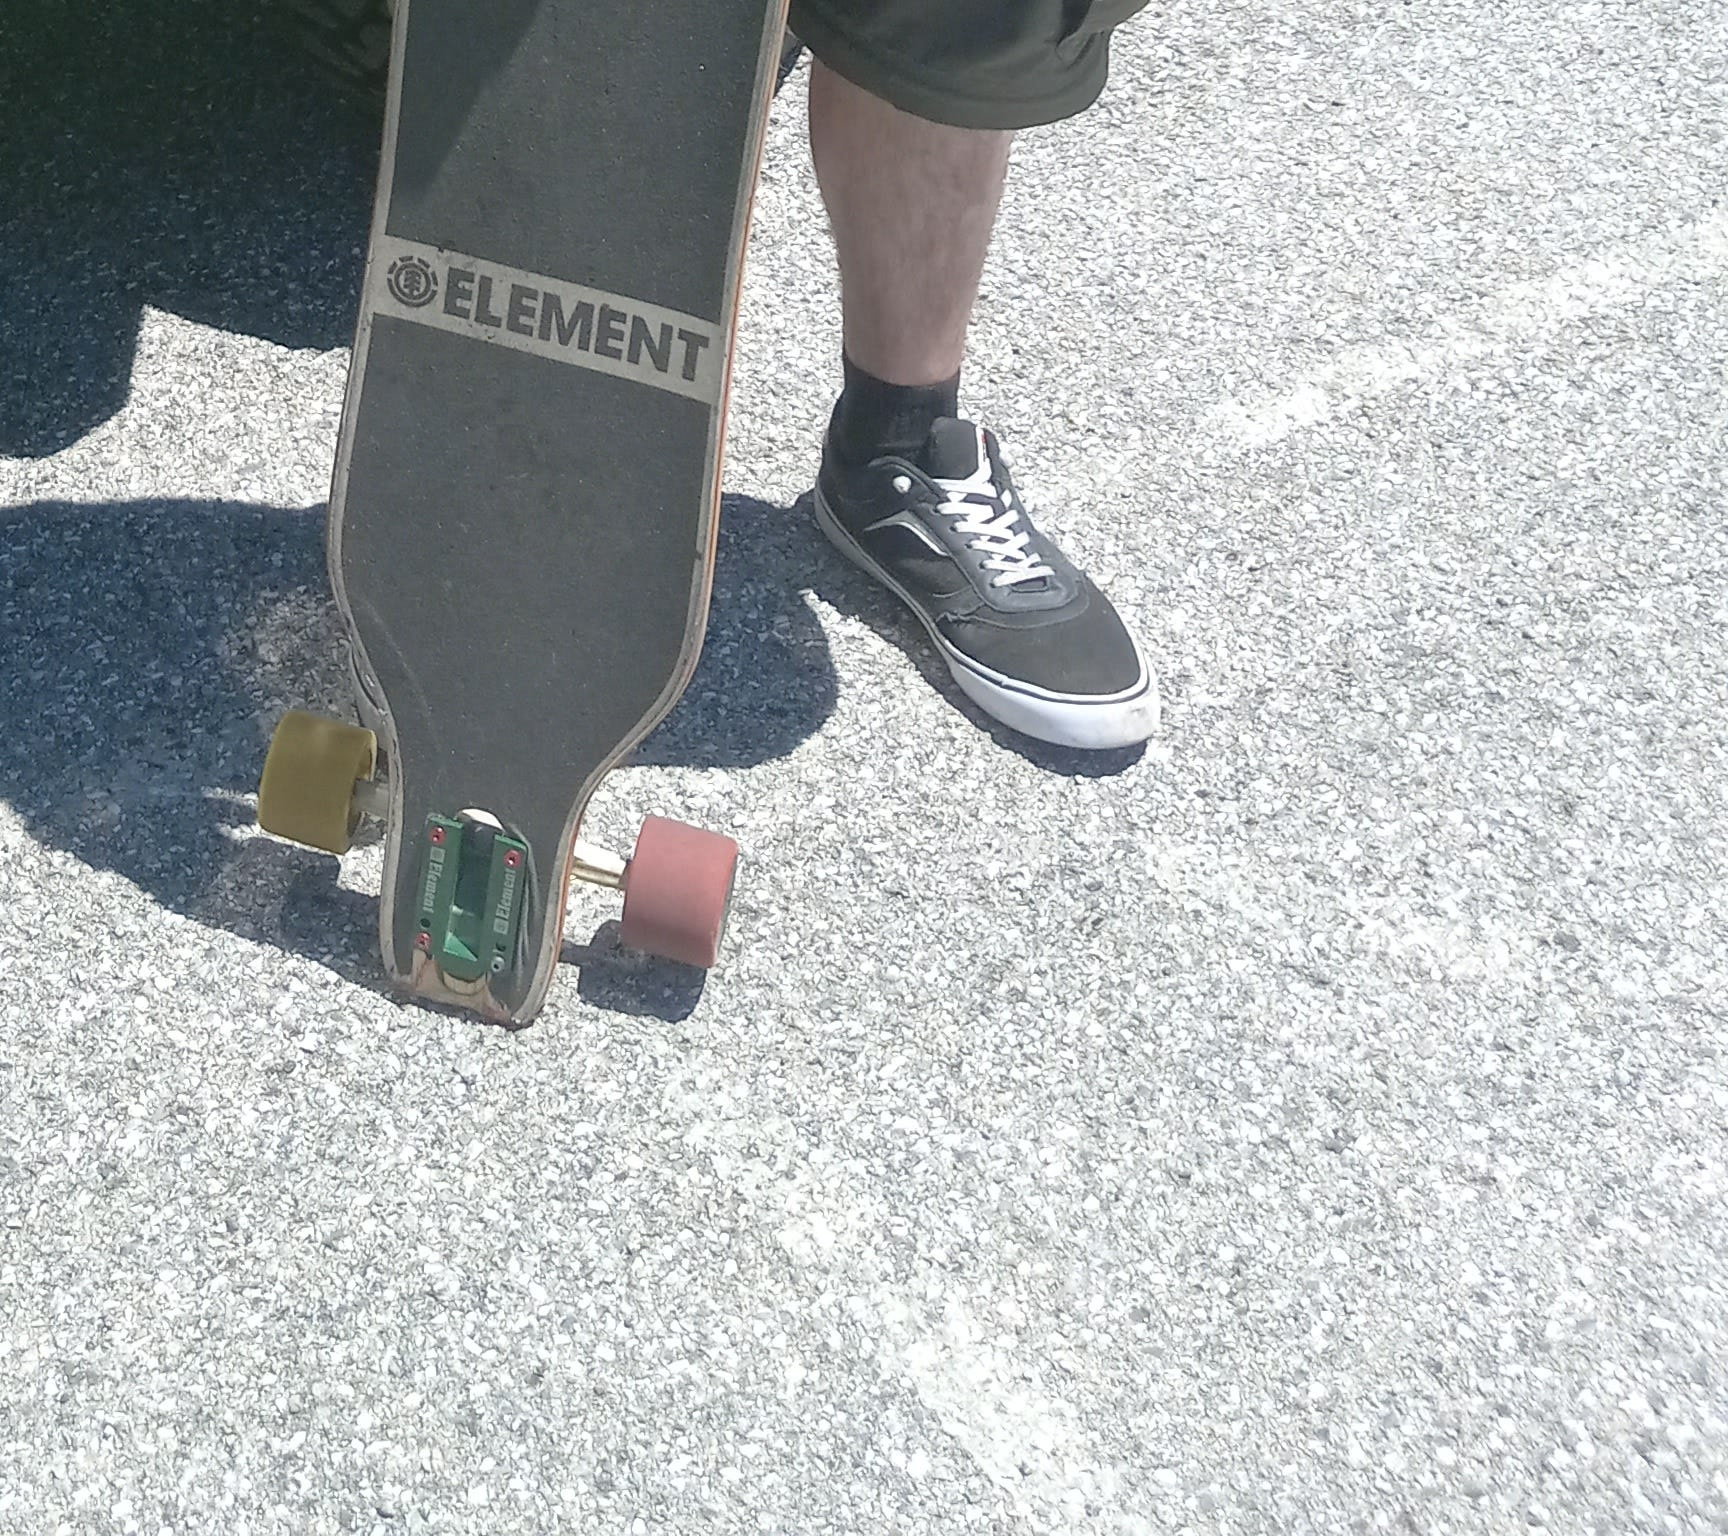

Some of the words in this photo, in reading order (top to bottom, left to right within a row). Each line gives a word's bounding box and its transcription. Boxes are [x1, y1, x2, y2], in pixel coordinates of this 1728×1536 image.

[443, 266, 709, 382] ELEMENT
[422, 861, 444, 914] Element
[495, 868, 516, 920] Element
